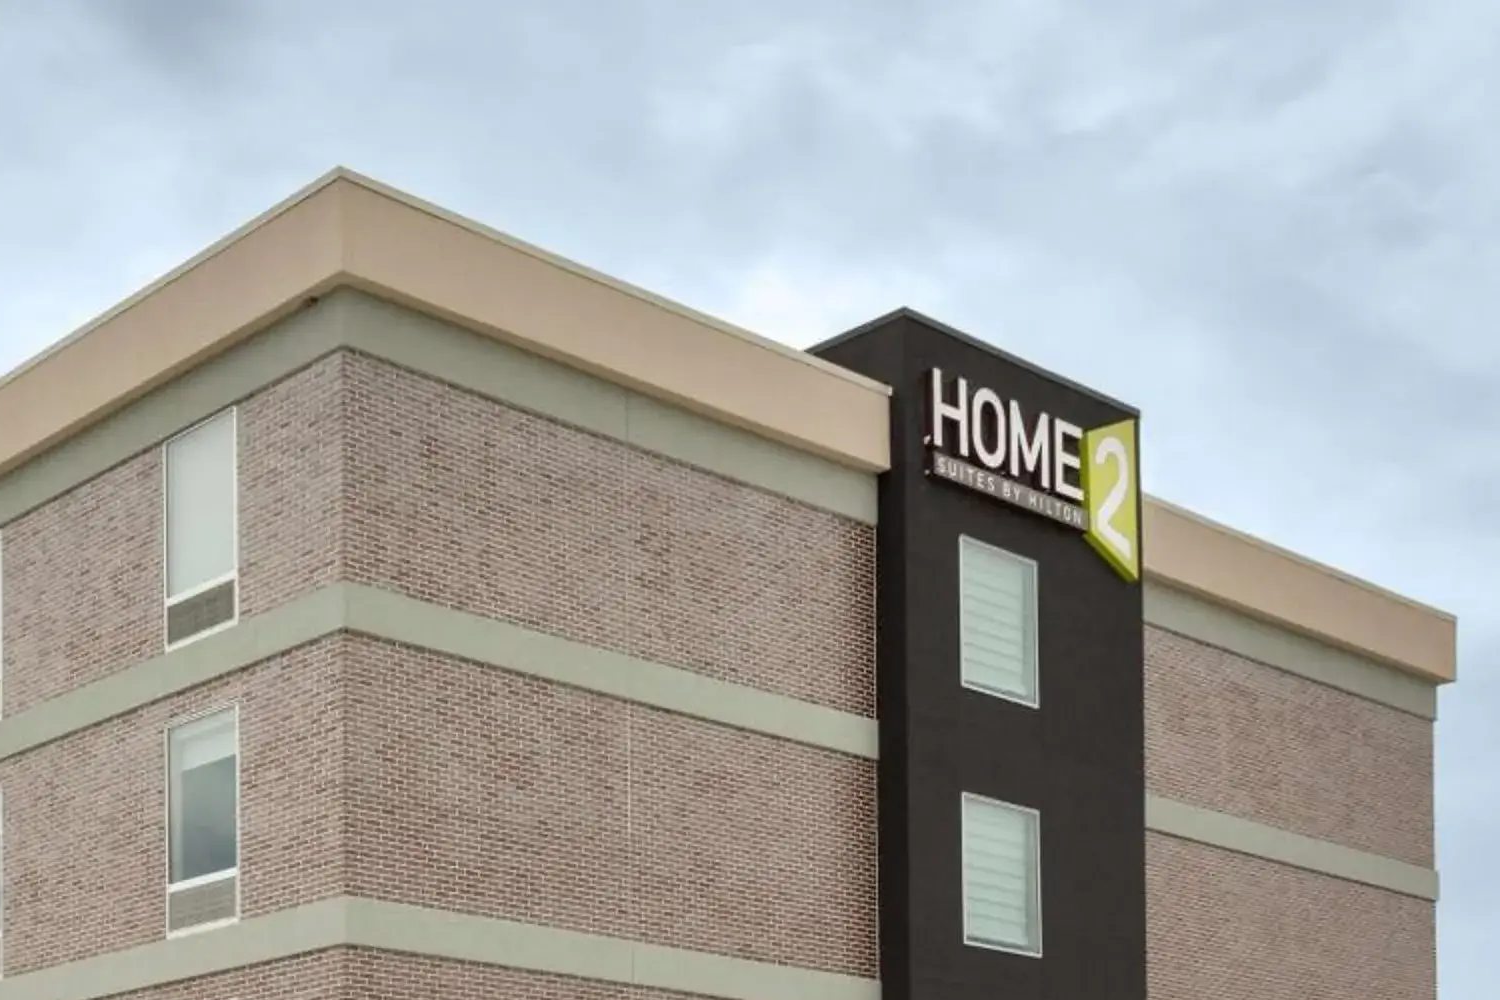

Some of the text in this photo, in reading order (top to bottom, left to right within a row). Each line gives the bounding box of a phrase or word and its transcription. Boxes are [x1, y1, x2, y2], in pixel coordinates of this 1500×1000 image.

[932, 366, 1132, 561] HOME 2
[937, 456, 1083, 526] SUITES BY HILTON
